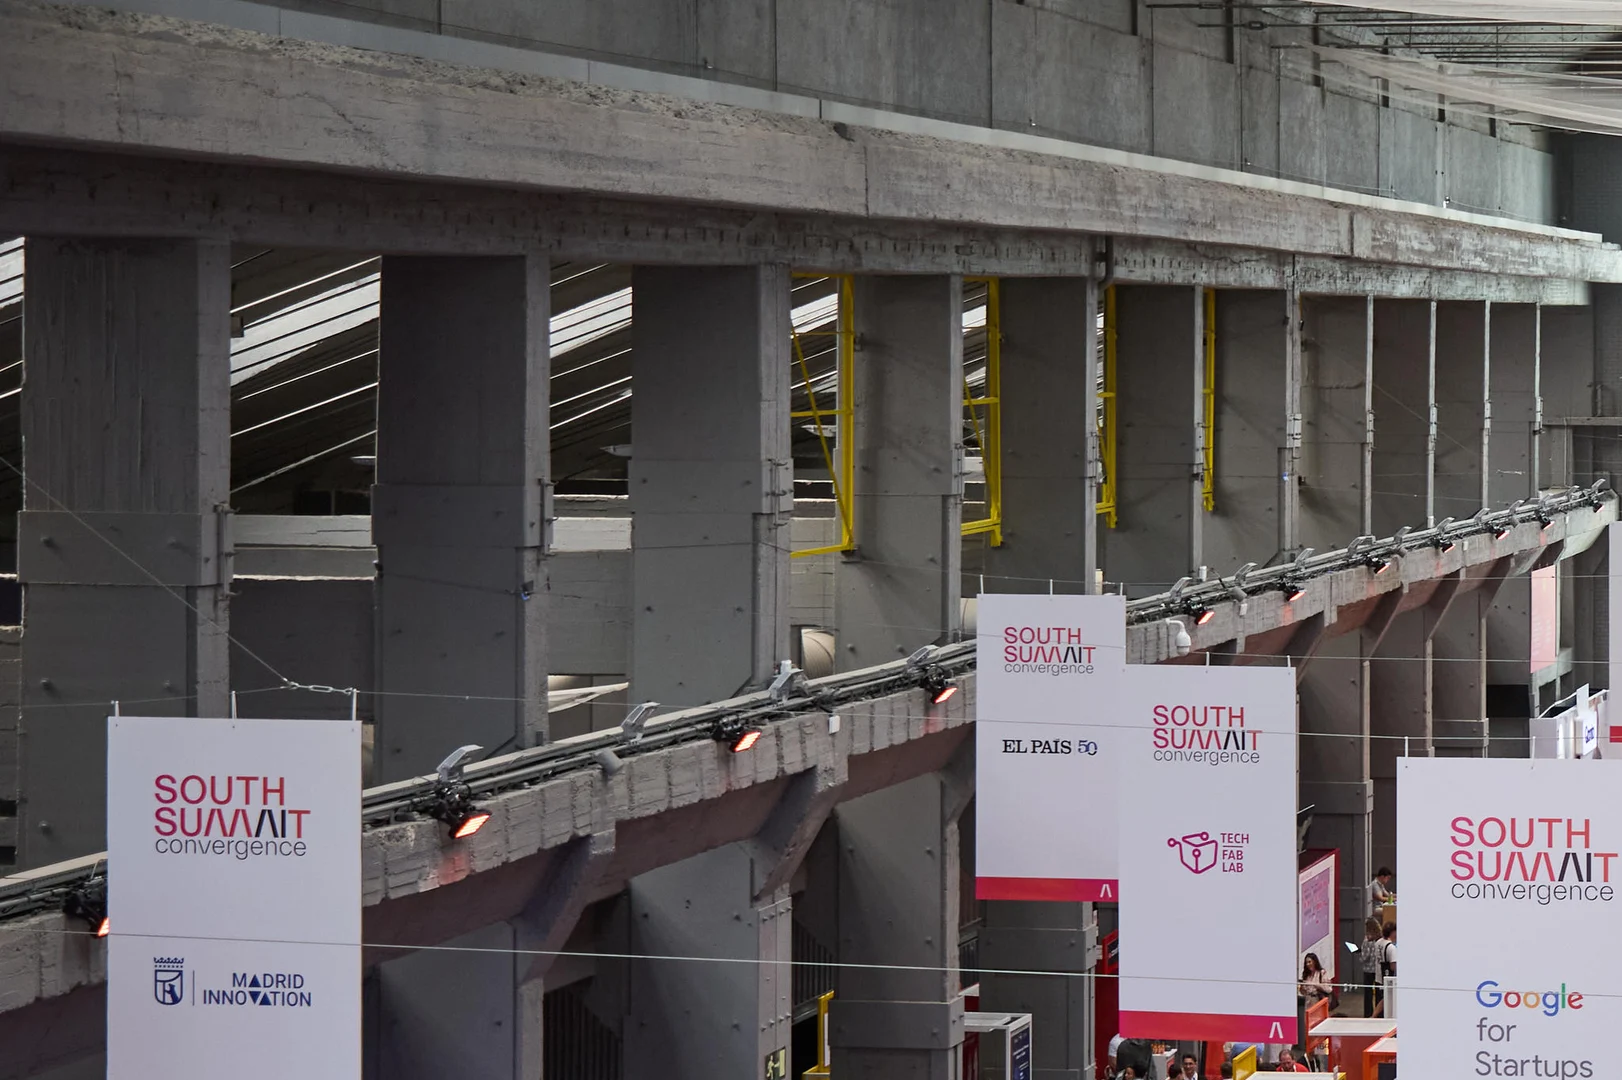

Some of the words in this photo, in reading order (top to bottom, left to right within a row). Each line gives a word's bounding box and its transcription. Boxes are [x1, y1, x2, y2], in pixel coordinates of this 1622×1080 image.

[1004, 627, 1081, 644] SOUTH
[1004, 647, 1096, 663] SUMMIT
[1004, 663, 1094, 676] convergence
[1153, 705, 1244, 727] SOUTH
[1002, 740, 1027, 754] EL
[1032, 738, 1071, 754] PAÍS
[1078, 740, 1097, 755] 50
[1153, 730, 1262, 750] SUMMIT
[1153, 750, 1260, 766] convergence
[154, 775, 285, 806] SOUTH
[154, 809, 311, 838] SUMMIT
[1221, 833, 1249, 844] TECH
[1450, 817, 1590, 849] SOUTH
[155, 837, 307, 860] convergence
[1222, 850, 1243, 860] FAB
[1222, 862, 1243, 873] LAB
[1450, 851, 1618, 882] SUMMIT
[1451, 882, 1614, 905] convergence
[232, 973, 304, 989] MADRID
[202, 990, 311, 1007] INNOVATION
[1476, 980, 1583, 1017] Google
[1476, 1017, 1517, 1042] for
